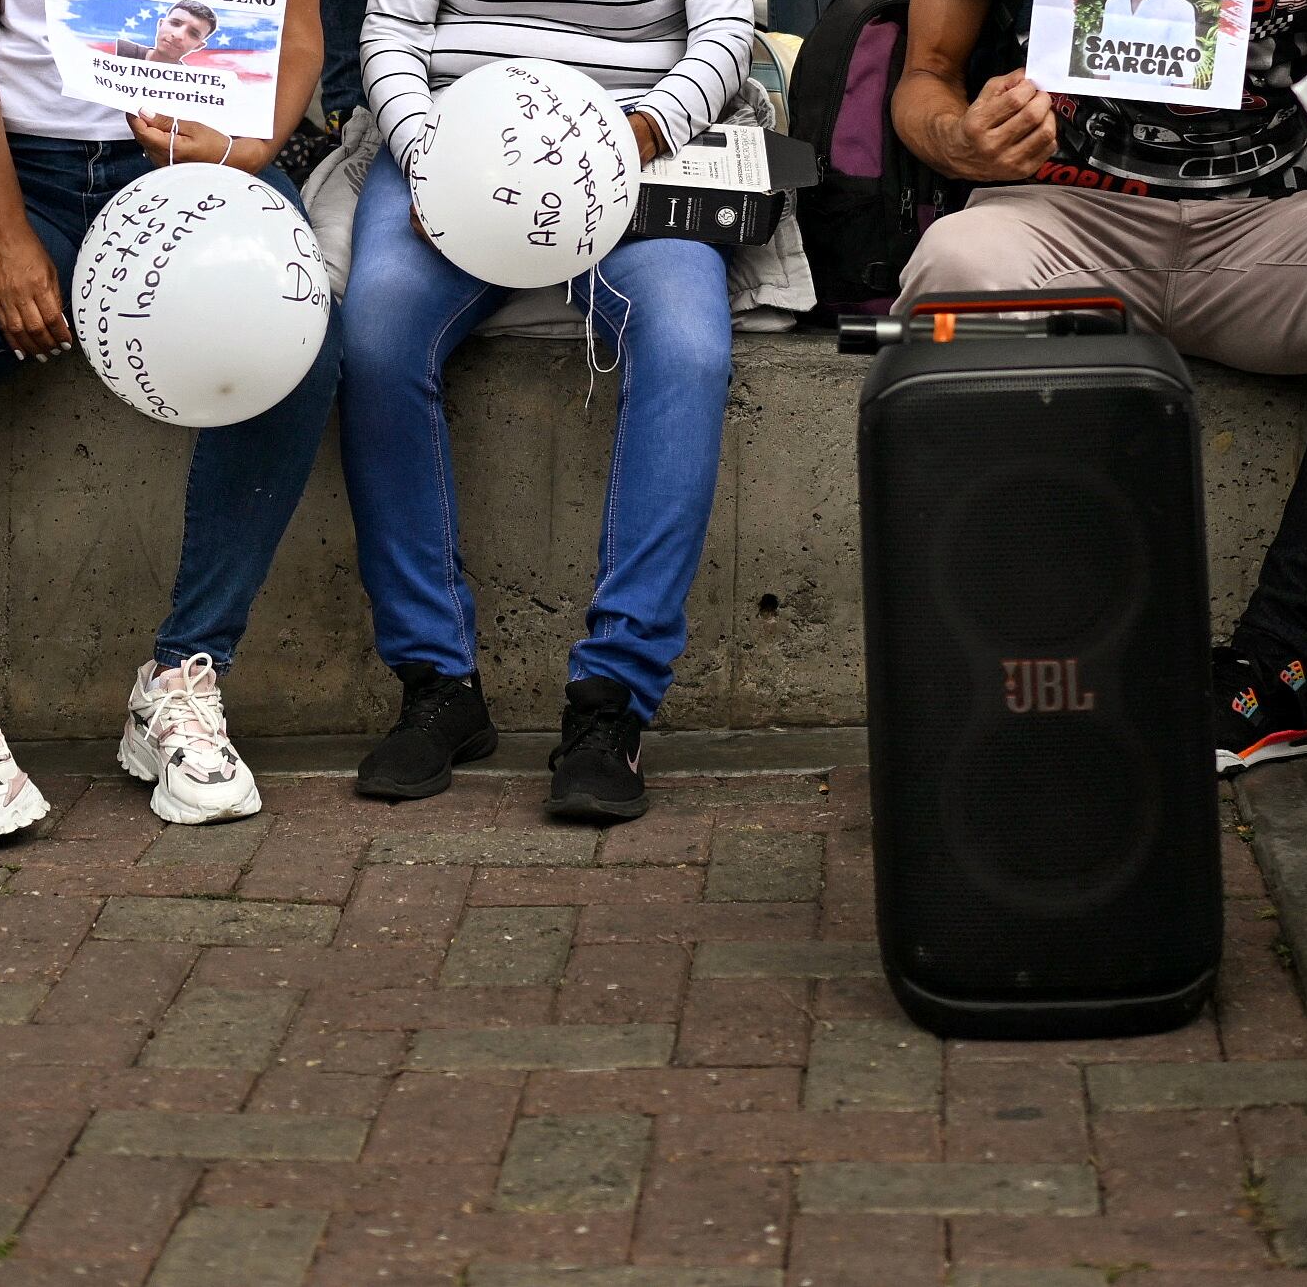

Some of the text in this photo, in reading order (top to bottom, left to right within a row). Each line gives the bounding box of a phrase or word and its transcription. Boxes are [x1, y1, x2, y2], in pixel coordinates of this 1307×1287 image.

[1085, 35, 1202, 63] SANTIAGO
[93, 74, 226, 107] NO soy terrorista
[130, 65, 227, 89] INOCENTE,
[527, 191, 562, 247] AÑO
[999, 659, 1096, 713] JBL
